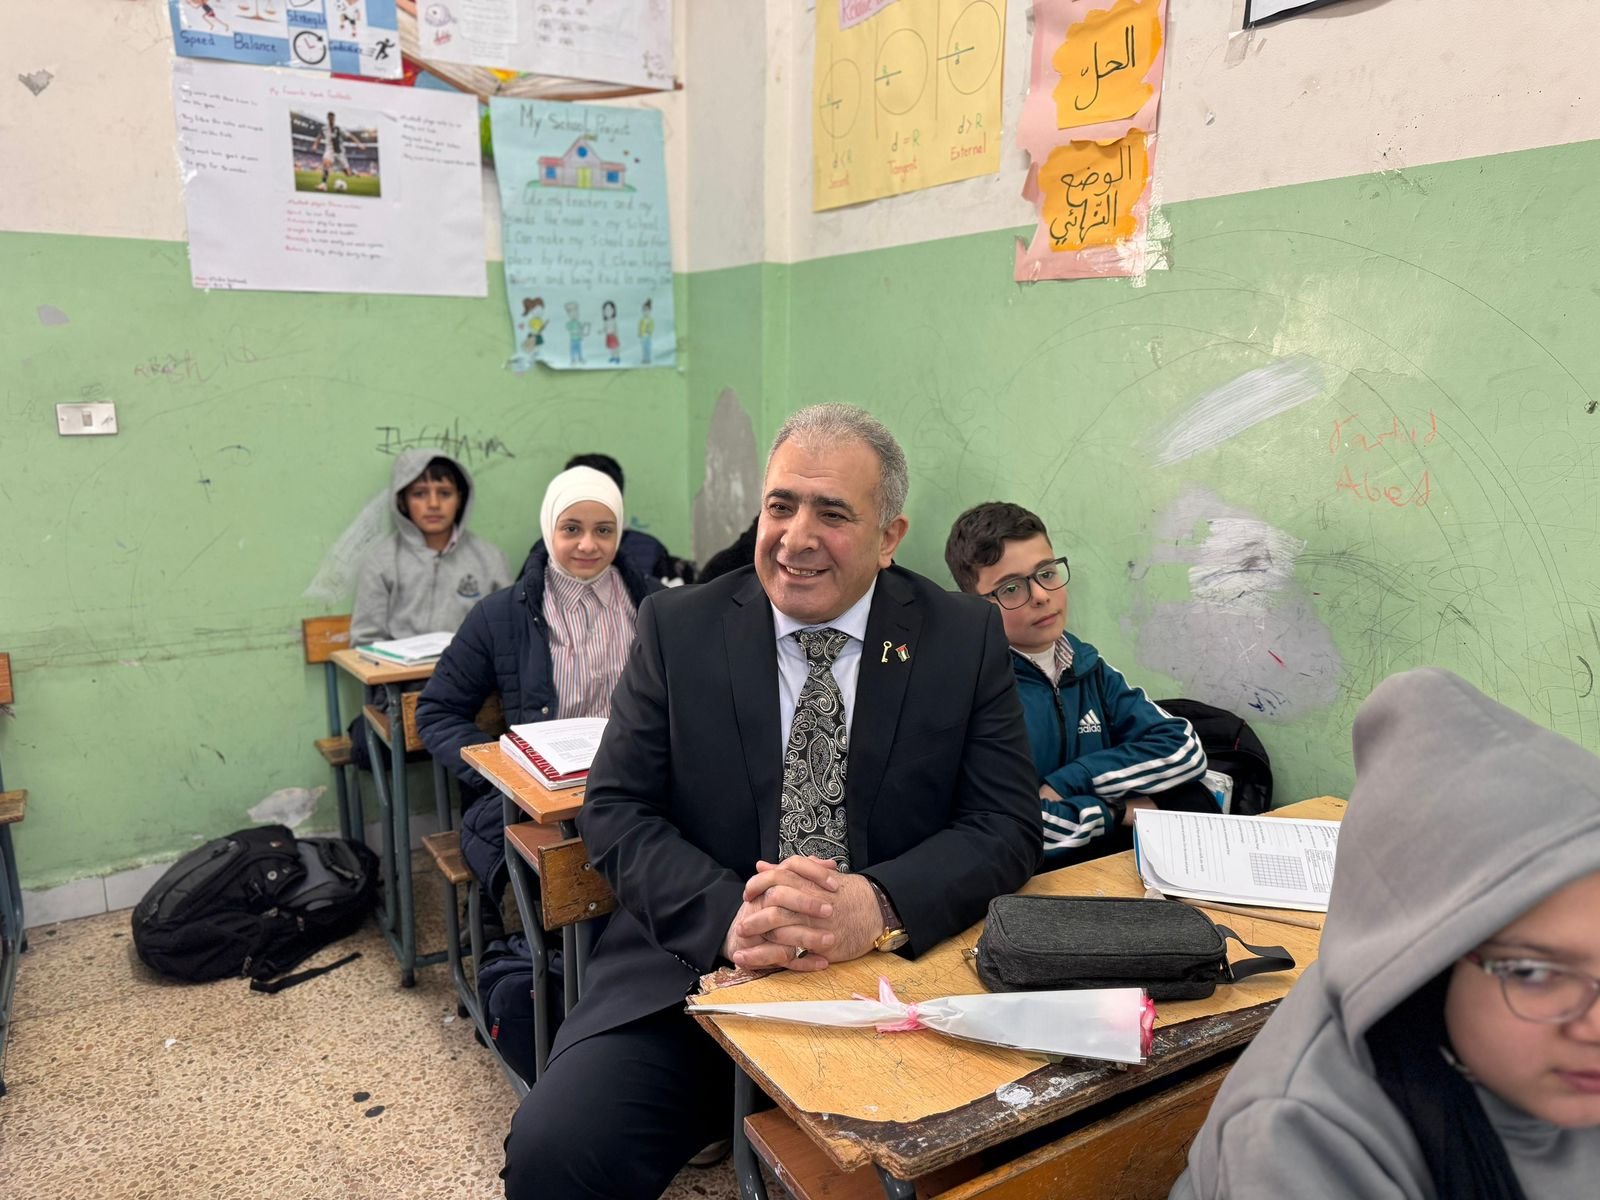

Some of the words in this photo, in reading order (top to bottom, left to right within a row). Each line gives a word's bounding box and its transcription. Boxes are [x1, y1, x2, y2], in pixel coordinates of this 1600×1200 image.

[180, 30, 216, 48] Speed
[234, 32, 277, 52] Balance
[520, 103, 542, 138] My
[548, 108, 591, 133] School
[950, 132, 987, 161] External
[1077, 723, 1102, 734] adida
